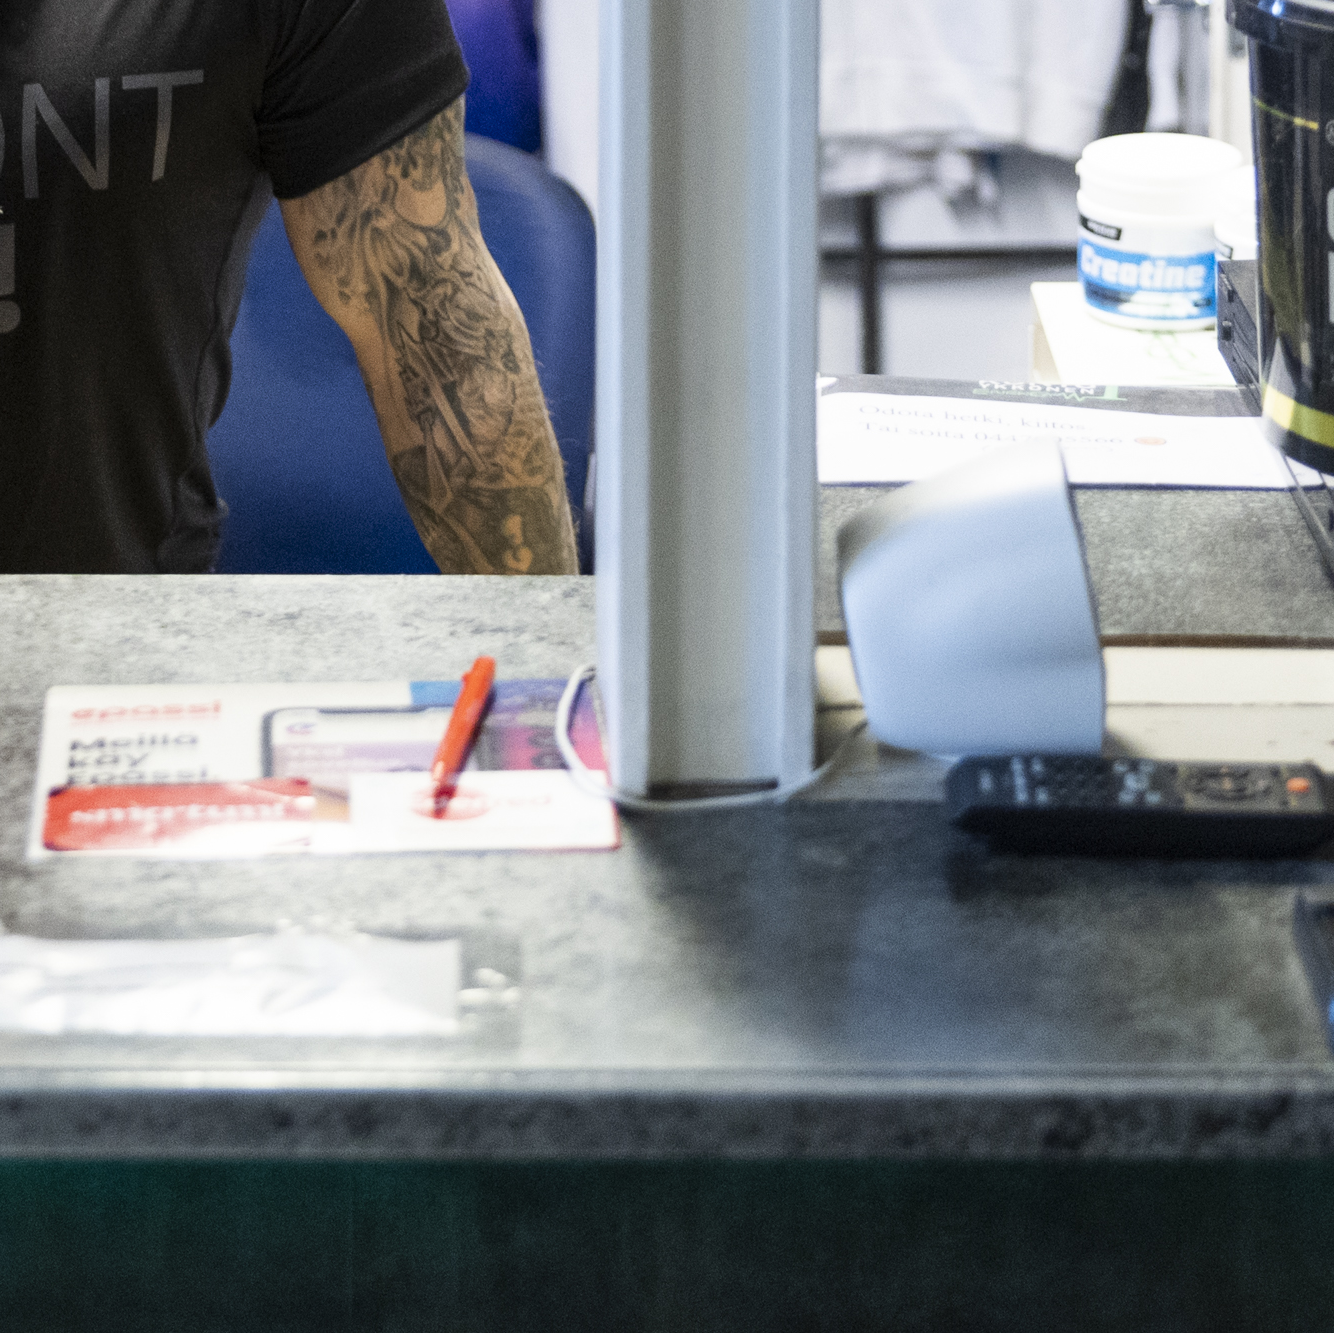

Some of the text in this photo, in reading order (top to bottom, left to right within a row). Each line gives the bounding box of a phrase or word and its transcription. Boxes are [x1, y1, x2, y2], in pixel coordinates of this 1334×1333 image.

[1080, 243, 1207, 290] Creatine
[858, 404, 935, 419] Odota
[909, 427, 965, 441] soita
